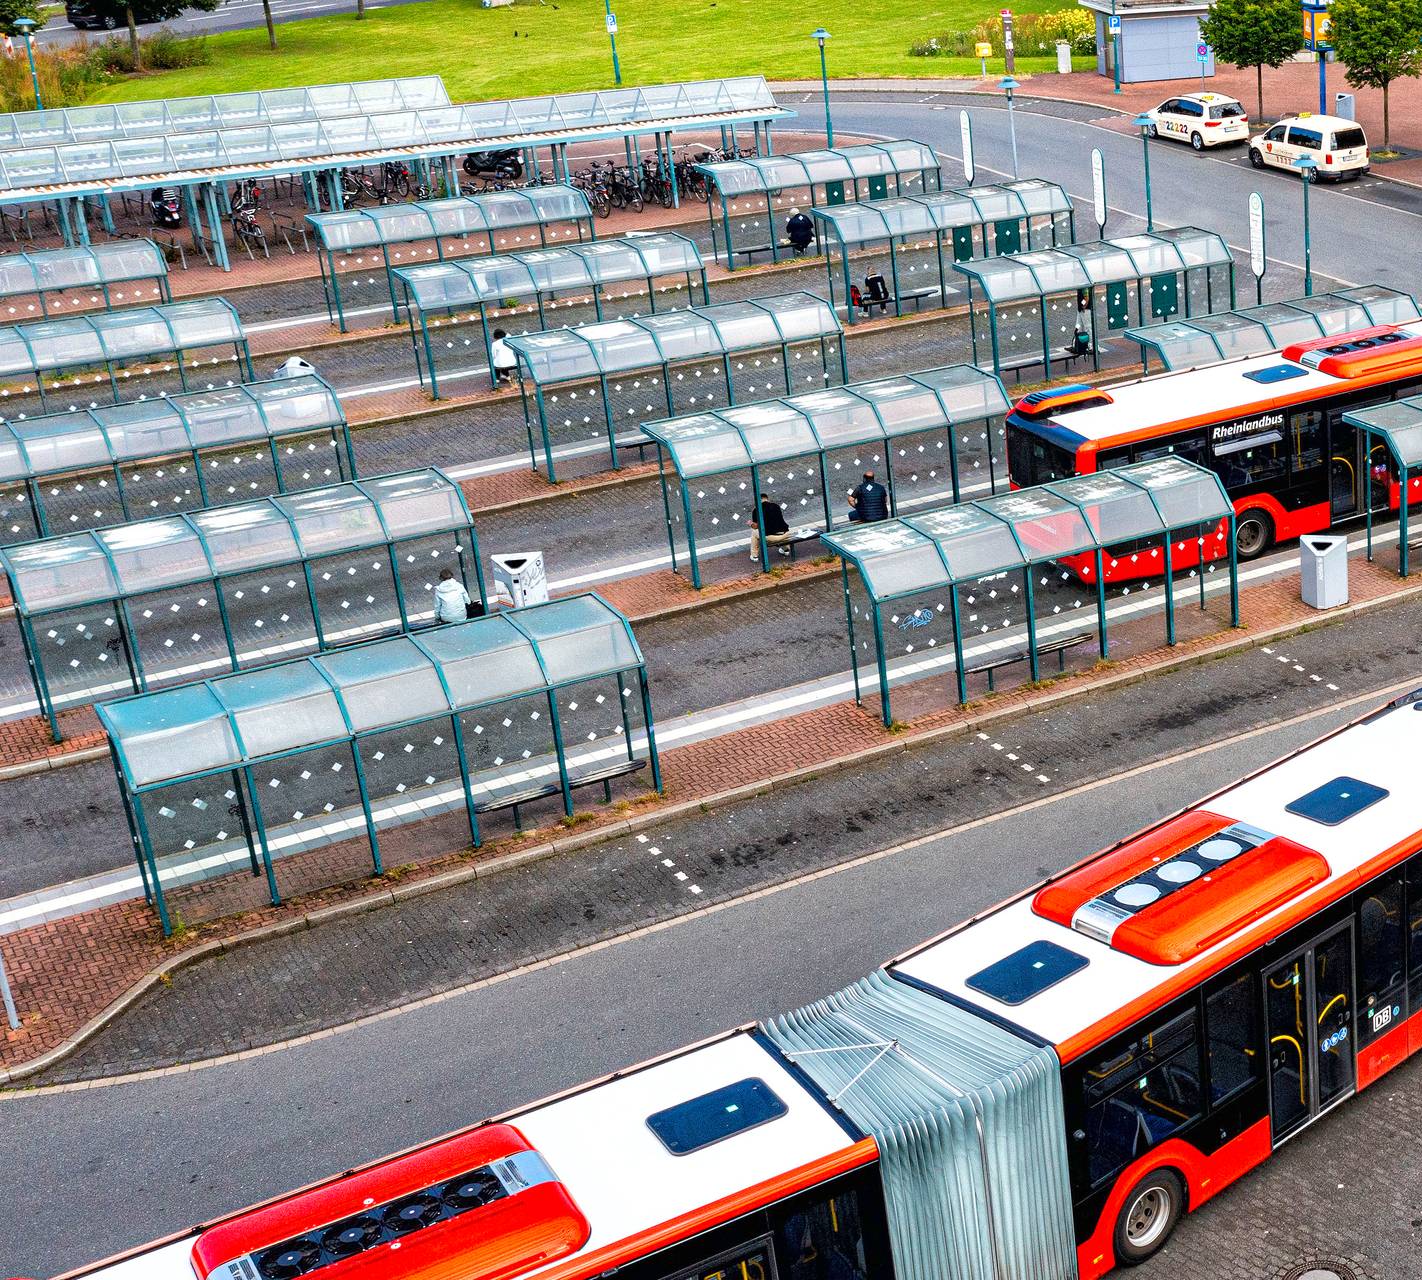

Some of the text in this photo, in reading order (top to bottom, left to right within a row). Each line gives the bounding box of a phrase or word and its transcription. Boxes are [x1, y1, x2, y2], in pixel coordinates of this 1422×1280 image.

[1111, 17, 1118, 27] P
[1166, 121, 1188, 134] 22222
[1212, 414, 1283, 439] Rheinlandbus
[1375, 1008, 1390, 1029] DB
